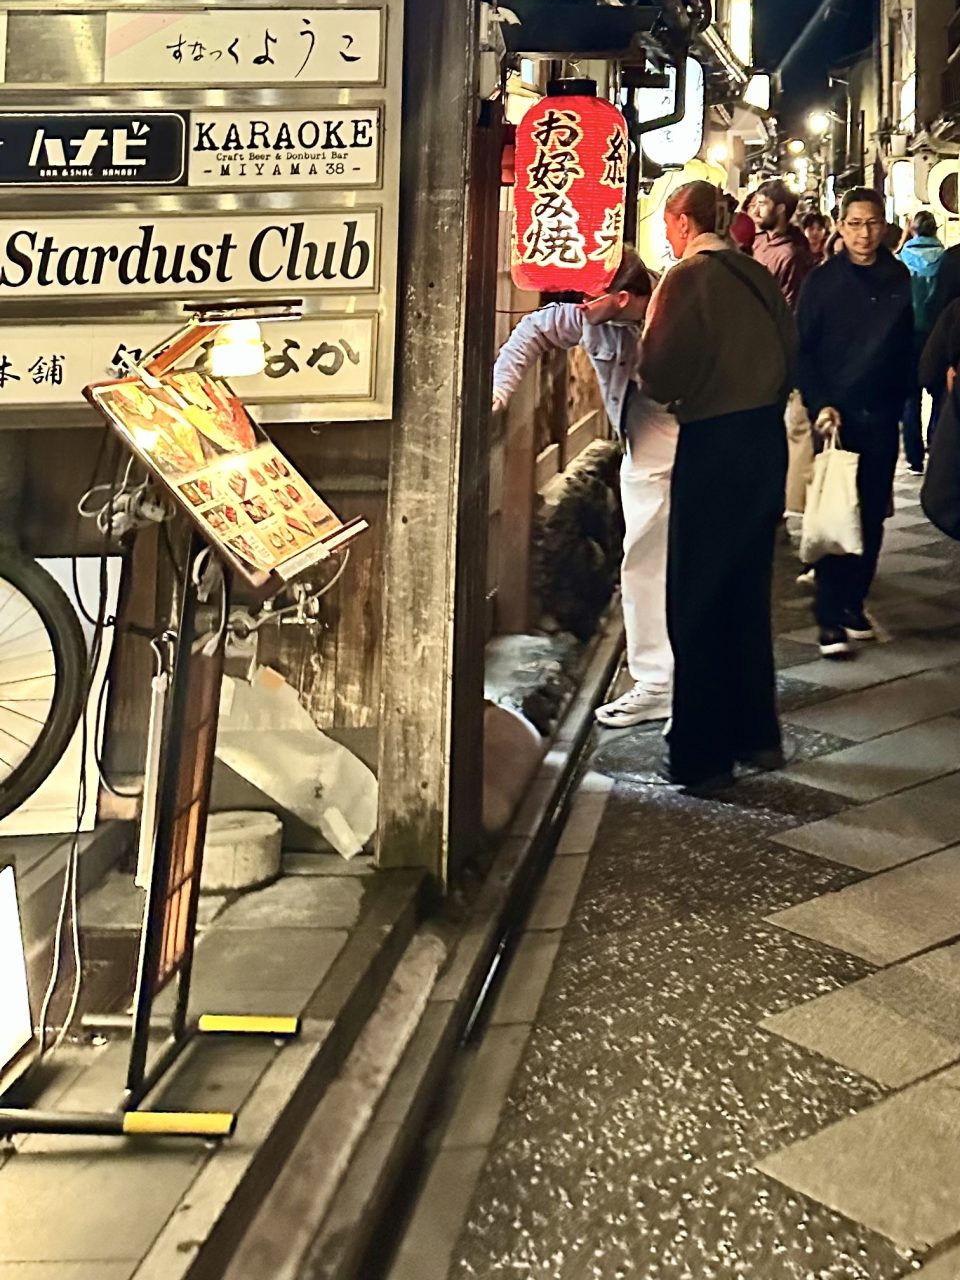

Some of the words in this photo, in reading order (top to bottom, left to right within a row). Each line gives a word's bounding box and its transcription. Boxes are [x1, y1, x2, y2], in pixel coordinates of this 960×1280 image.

[28, 121, 150, 166] ハナビ
[193, 119, 373, 151] KARAOKE
[216, 152, 244, 161] Craft
[248, 153, 271, 161] Beer
[286, 152, 326, 160] Donburi
[331, 151, 348, 160] Bar
[525, 109, 585, 266] お好み焼
[0, 224, 237, 287] Stardust
[249, 221, 370, 282] Club
